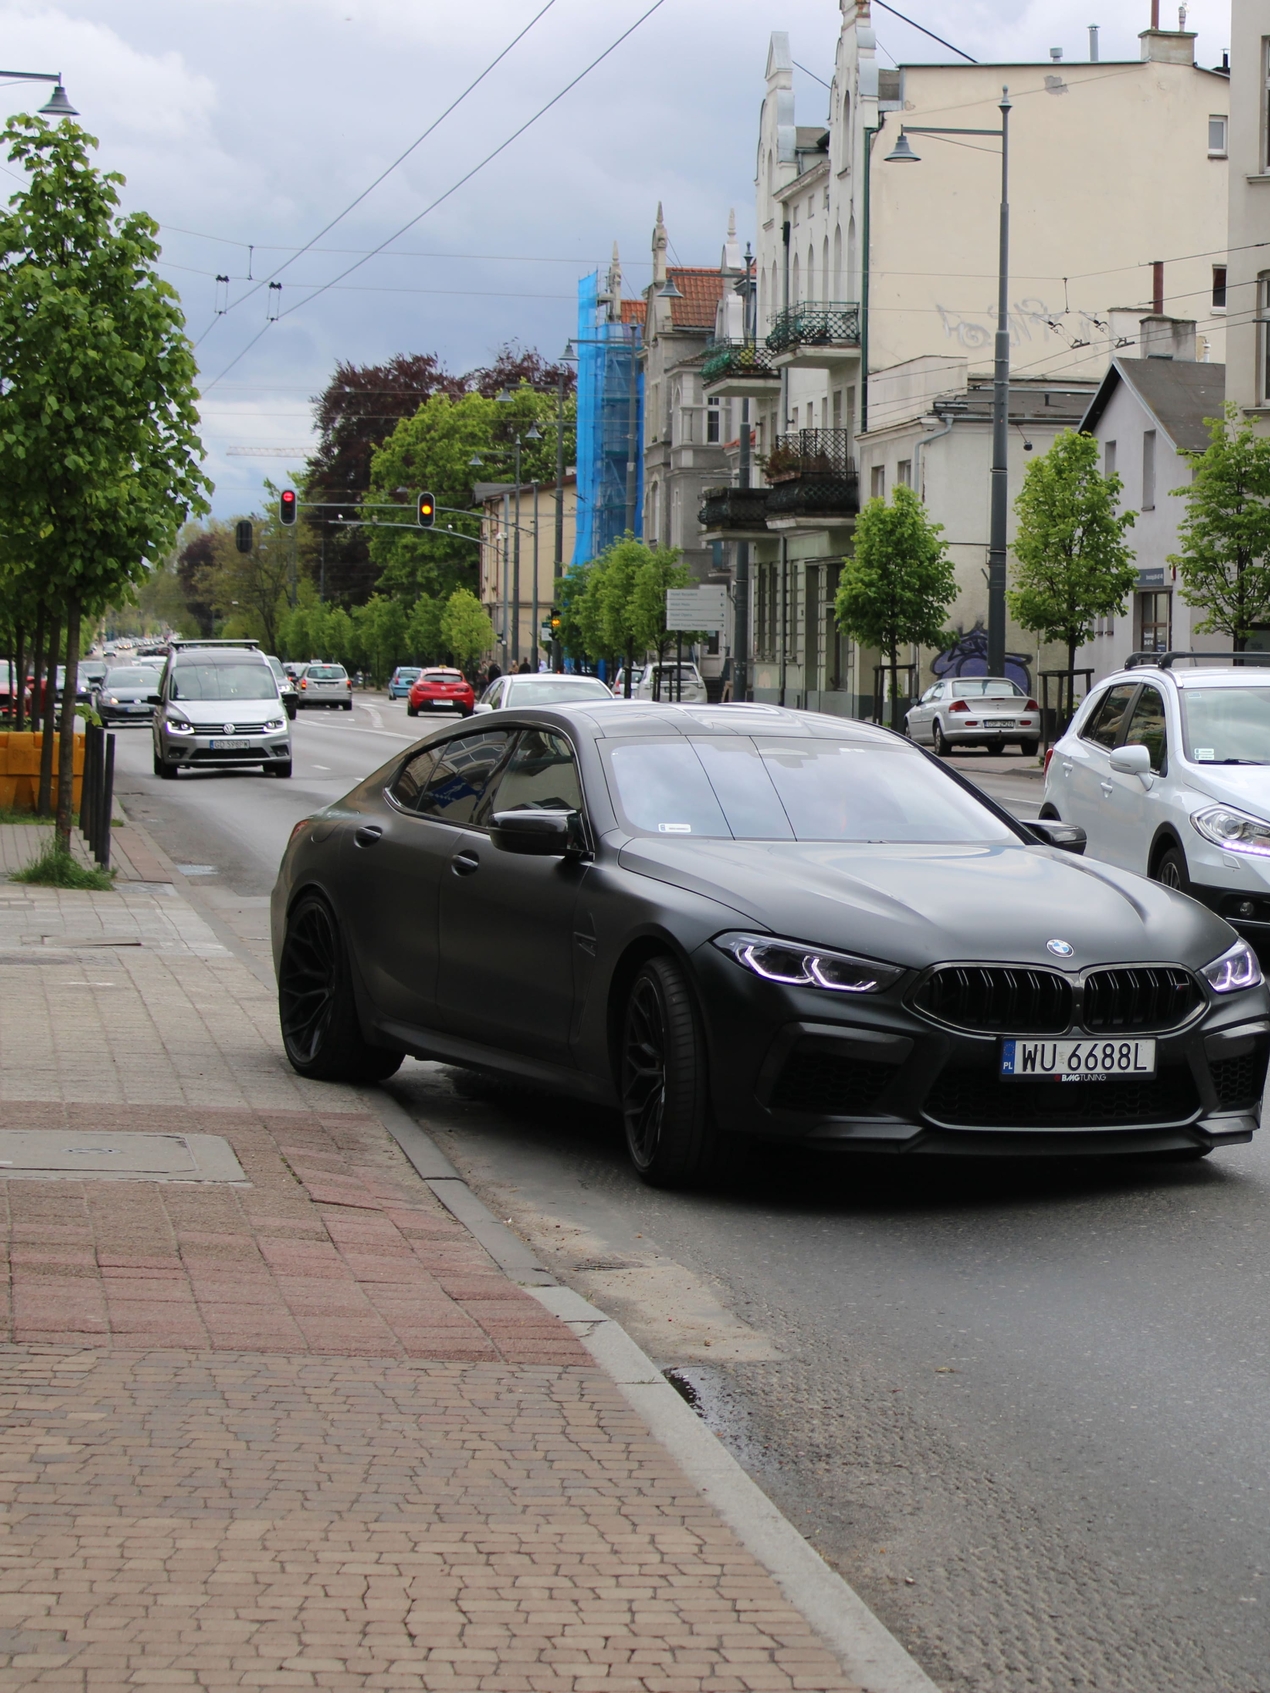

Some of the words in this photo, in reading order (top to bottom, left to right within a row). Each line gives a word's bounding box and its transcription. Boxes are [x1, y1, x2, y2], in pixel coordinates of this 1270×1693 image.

[1003, 1061, 1013, 1070] PL
[1022, 1043, 1057, 1072] WU
[1067, 1043, 1147, 1071] 6688L
